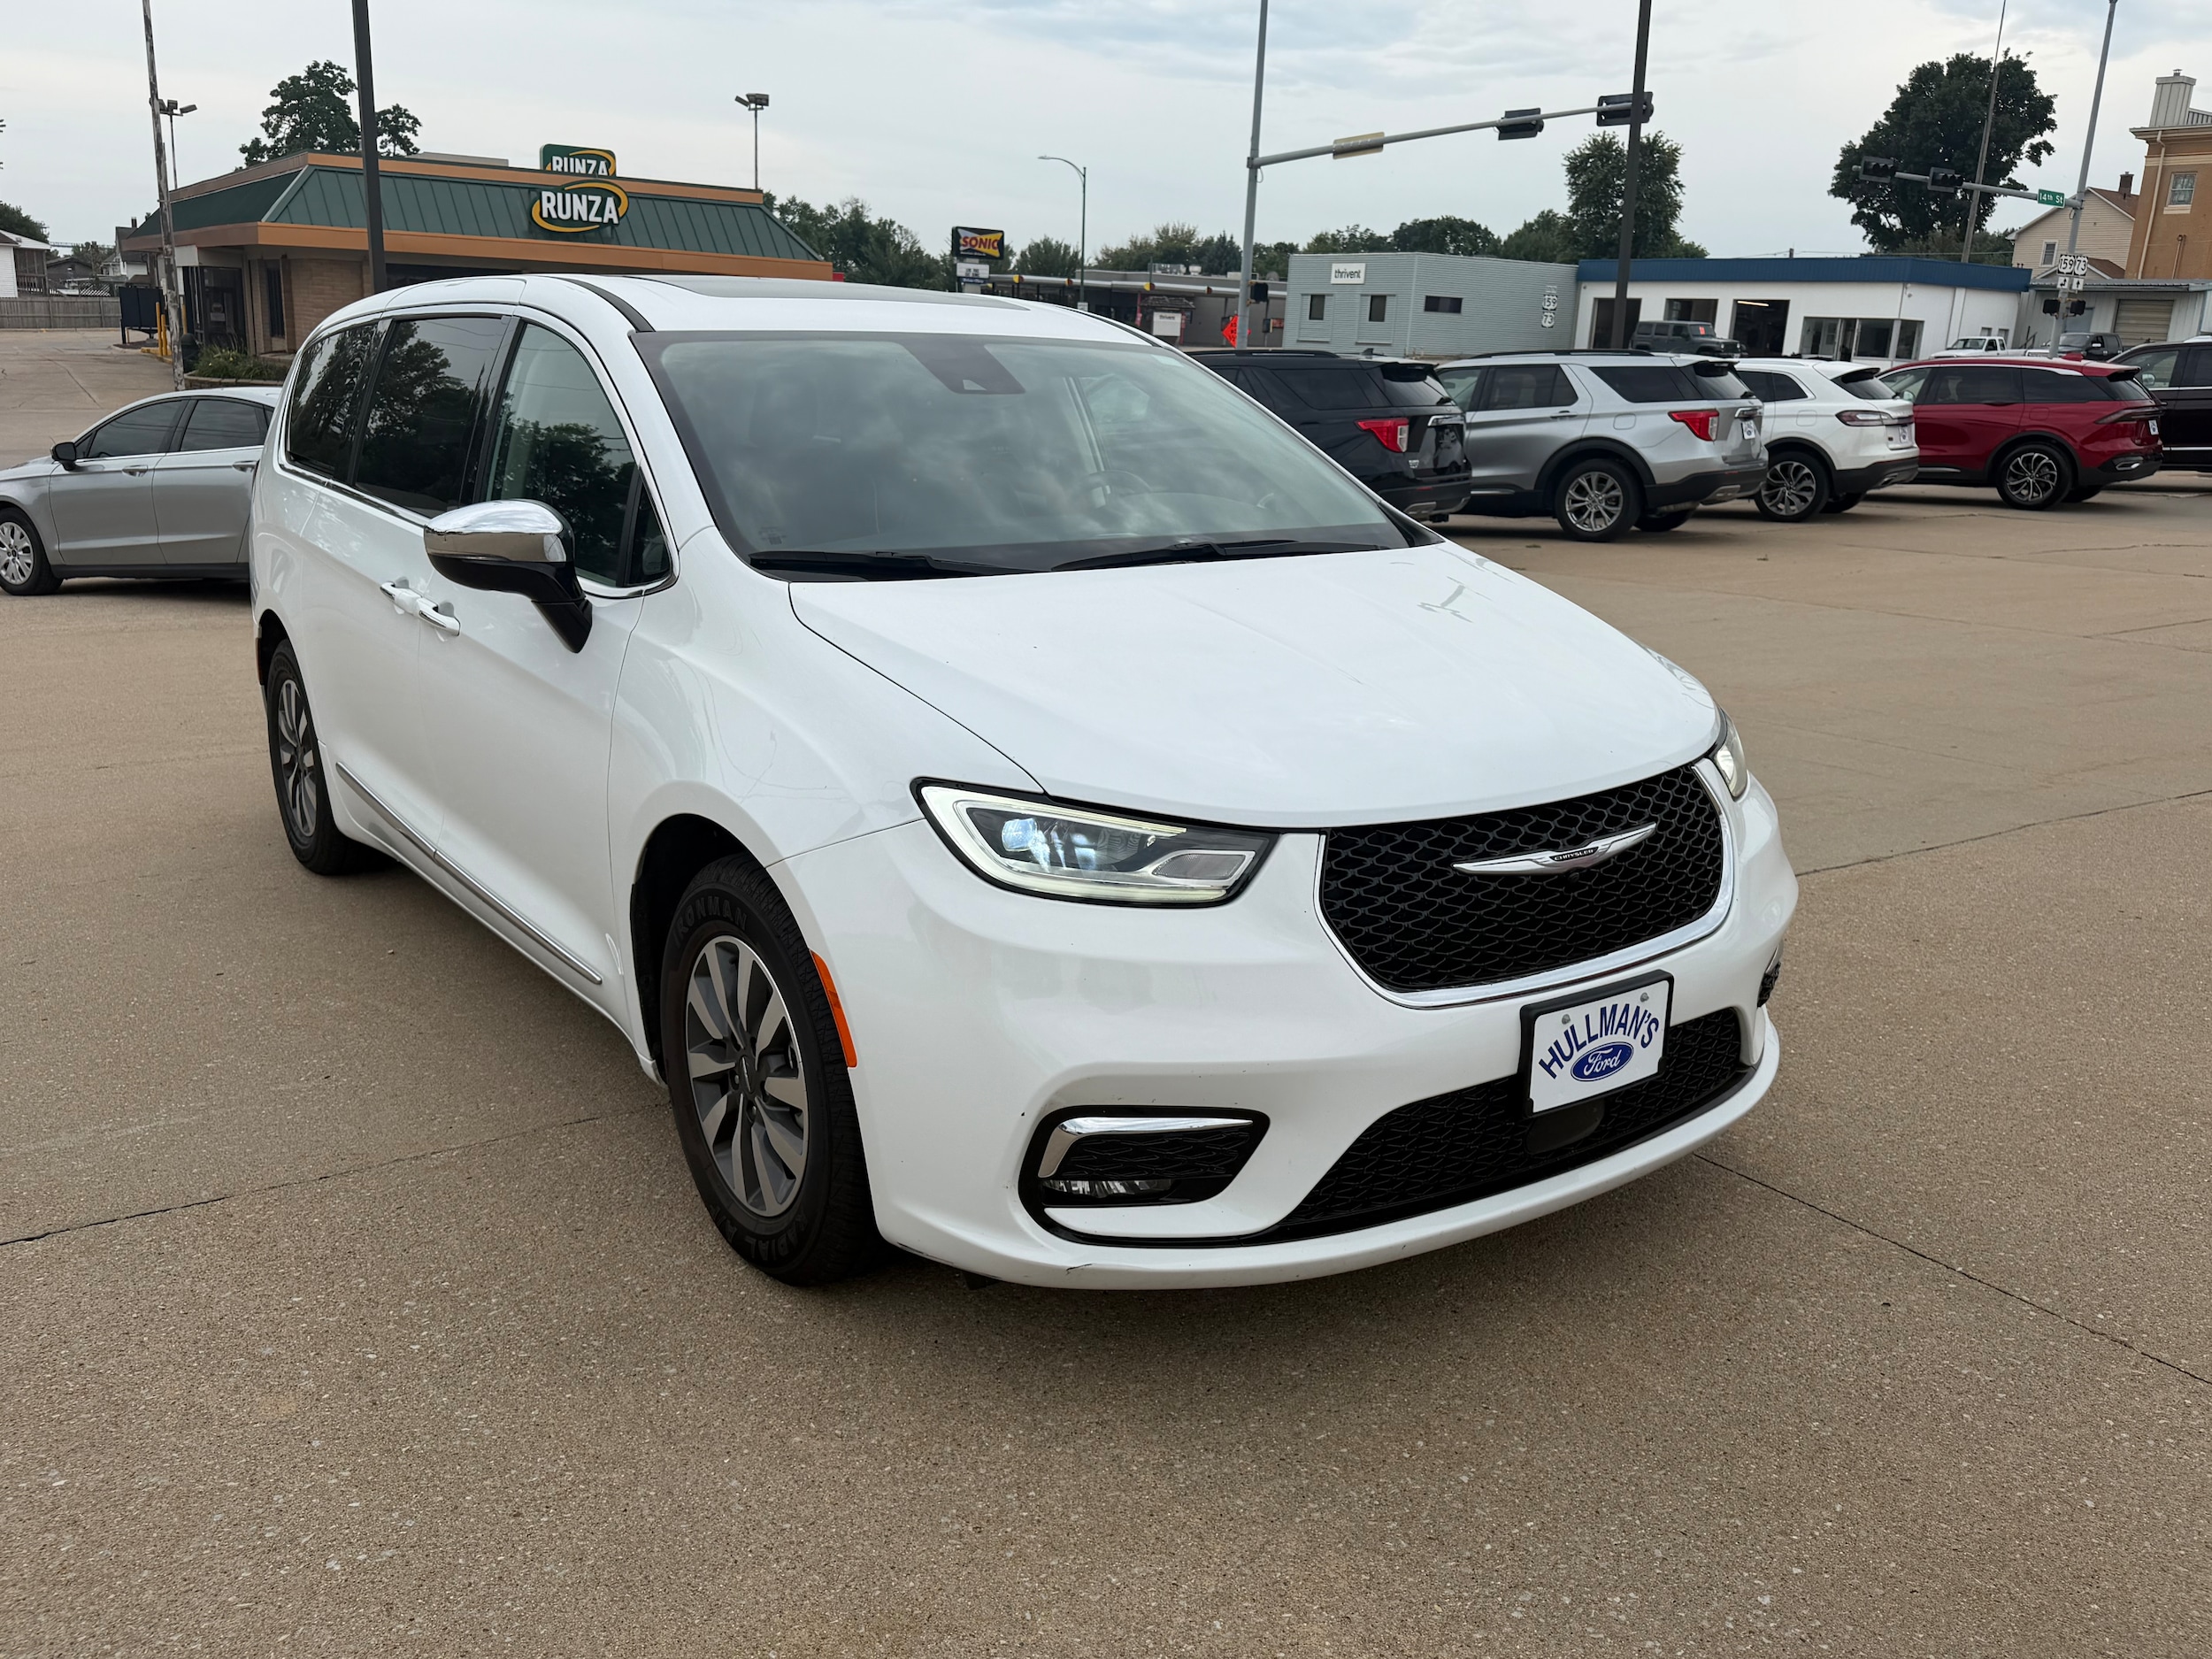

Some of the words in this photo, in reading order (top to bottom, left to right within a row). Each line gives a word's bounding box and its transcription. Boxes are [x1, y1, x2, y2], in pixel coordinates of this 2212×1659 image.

[552, 156, 609, 176] RUNZA
[2039, 192, 2054, 202] 14th
[2055, 195, 2063, 204] St
[541, 190, 619, 225] RUNZA
[962, 236, 998, 250] SONIC
[2060, 258, 2074, 270] 159
[2077, 259, 2086, 271] 73
[1334, 268, 1361, 279] thrivent
[1543, 297, 1557, 307] 159
[1543, 314, 1553, 324] 73
[1554, 849, 1595, 861] CHRYSLER
[672, 895, 748, 948] IRONMAN
[1538, 1003, 1660, 1079] HULLMAN'S
[1583, 1047, 1623, 1077] Ford
